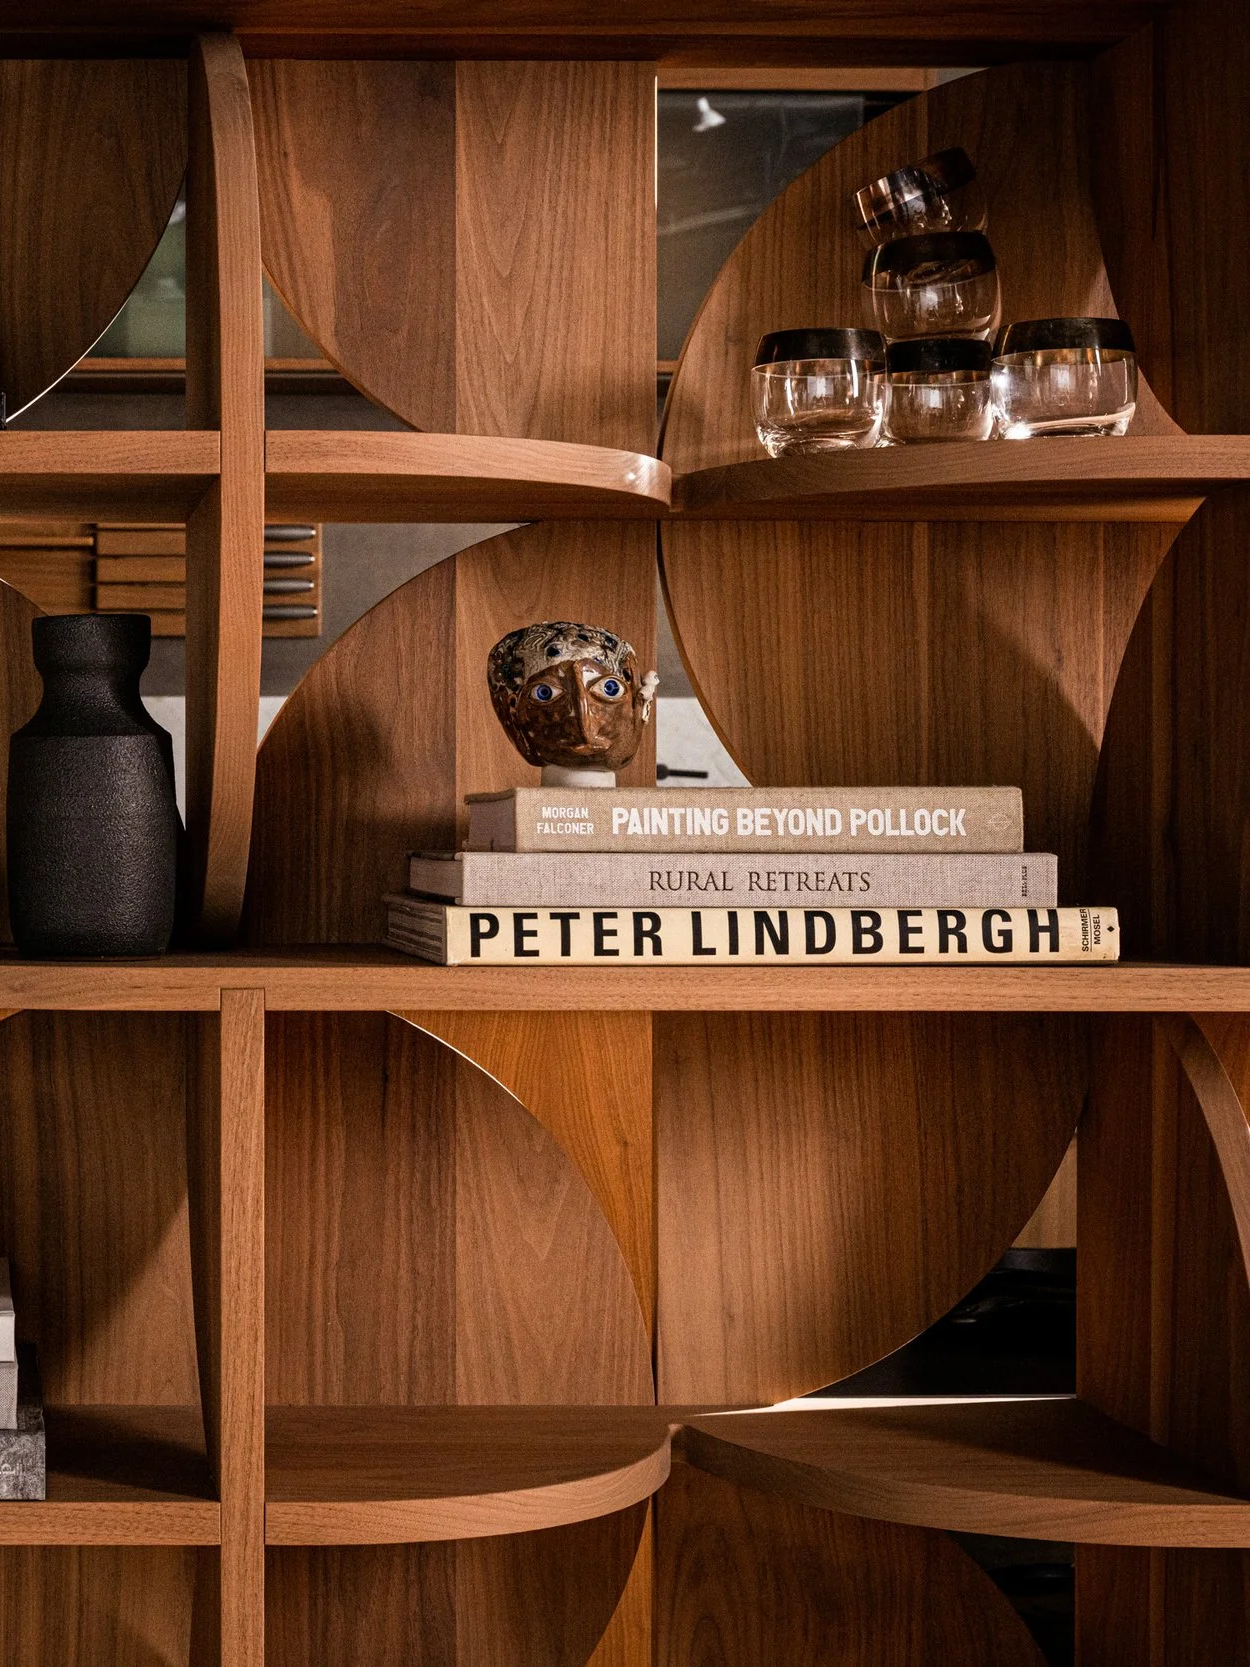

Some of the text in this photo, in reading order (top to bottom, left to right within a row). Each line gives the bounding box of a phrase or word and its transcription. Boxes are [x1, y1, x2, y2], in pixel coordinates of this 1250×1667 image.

[542, 806, 589, 819] MORGAN
[612, 807, 967, 837] PAINTING BEYOND POLLOCK
[536, 822, 594, 835] FALCONER
[648, 871, 871, 892] RURAL RETREATS
[470, 909, 1060, 957] PETER LINDBERGH
[1079, 908, 1089, 951] SCHIRMER
[1093, 914, 1101, 944] MOSEL
